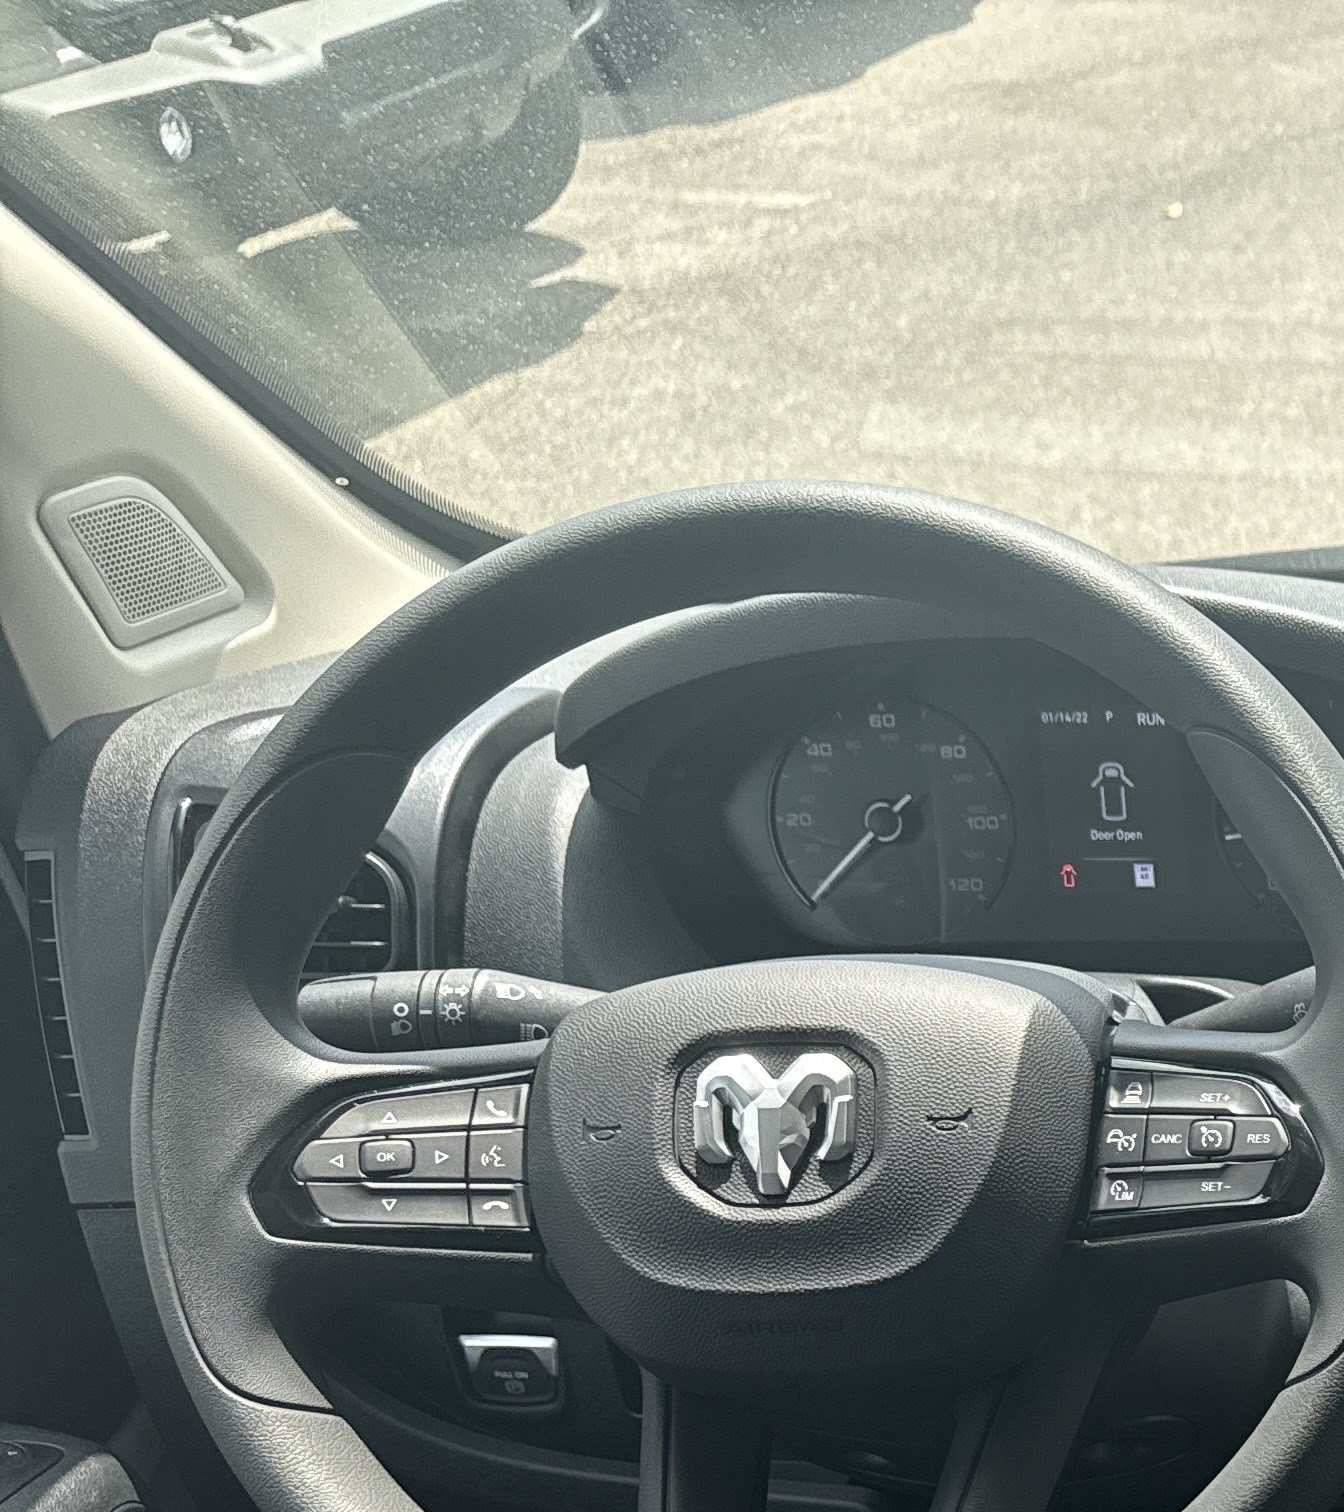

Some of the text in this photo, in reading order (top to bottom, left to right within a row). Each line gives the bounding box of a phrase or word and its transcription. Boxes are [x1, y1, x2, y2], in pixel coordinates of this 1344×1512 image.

[869, 714, 895, 728] 60
[1106, 711, 1114, 722] P
[1137, 712, 1166, 726] RUN
[806, 743, 833, 757] 40
[940, 745, 967, 759] 80
[786, 813, 812, 827] 20
[966, 816, 999, 830] 100
[1090, 829, 1143, 842] Door Open
[949, 877, 983, 892] 120
[1200, 1093, 1231, 1103] SET+
[1151, 1134, 1183, 1144] CANC
[1246, 1133, 1271, 1144] RES
[375, 1151, 396, 1163] OK
[515, 1371, 529, 1379] ON
